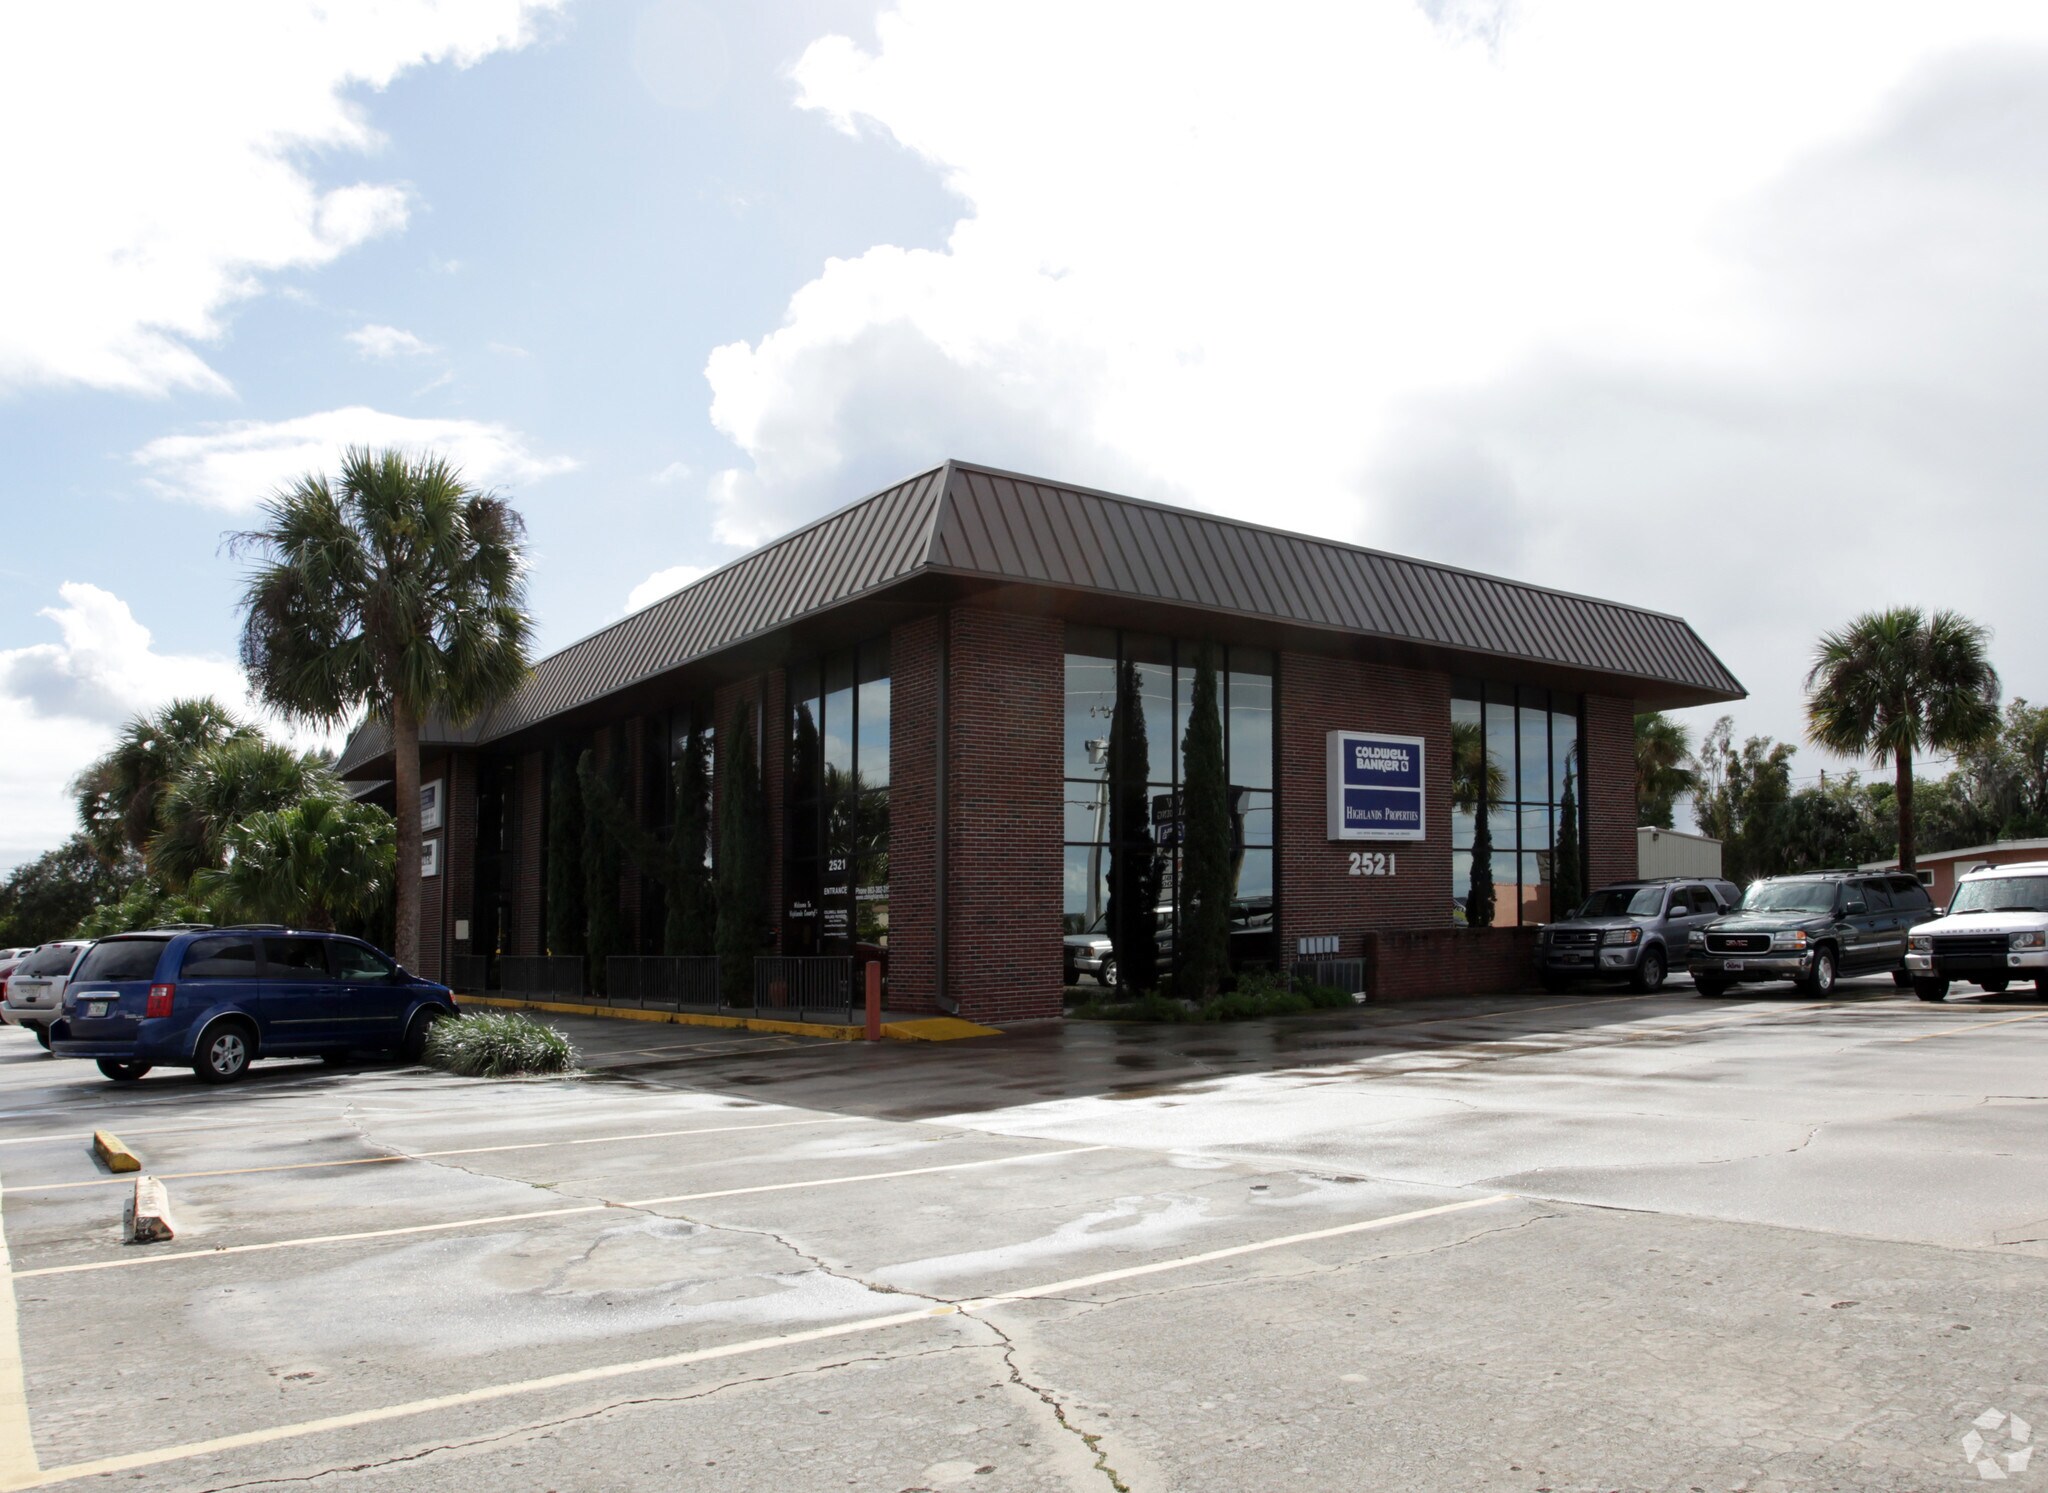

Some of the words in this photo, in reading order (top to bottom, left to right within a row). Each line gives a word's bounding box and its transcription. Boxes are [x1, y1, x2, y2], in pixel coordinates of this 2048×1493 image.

[828, 859, 846, 871] 2521
[1349, 852, 1396, 876] 2521
[824, 886, 847, 895] ENTRANCE
[1725, 939, 1749, 947] GMC
